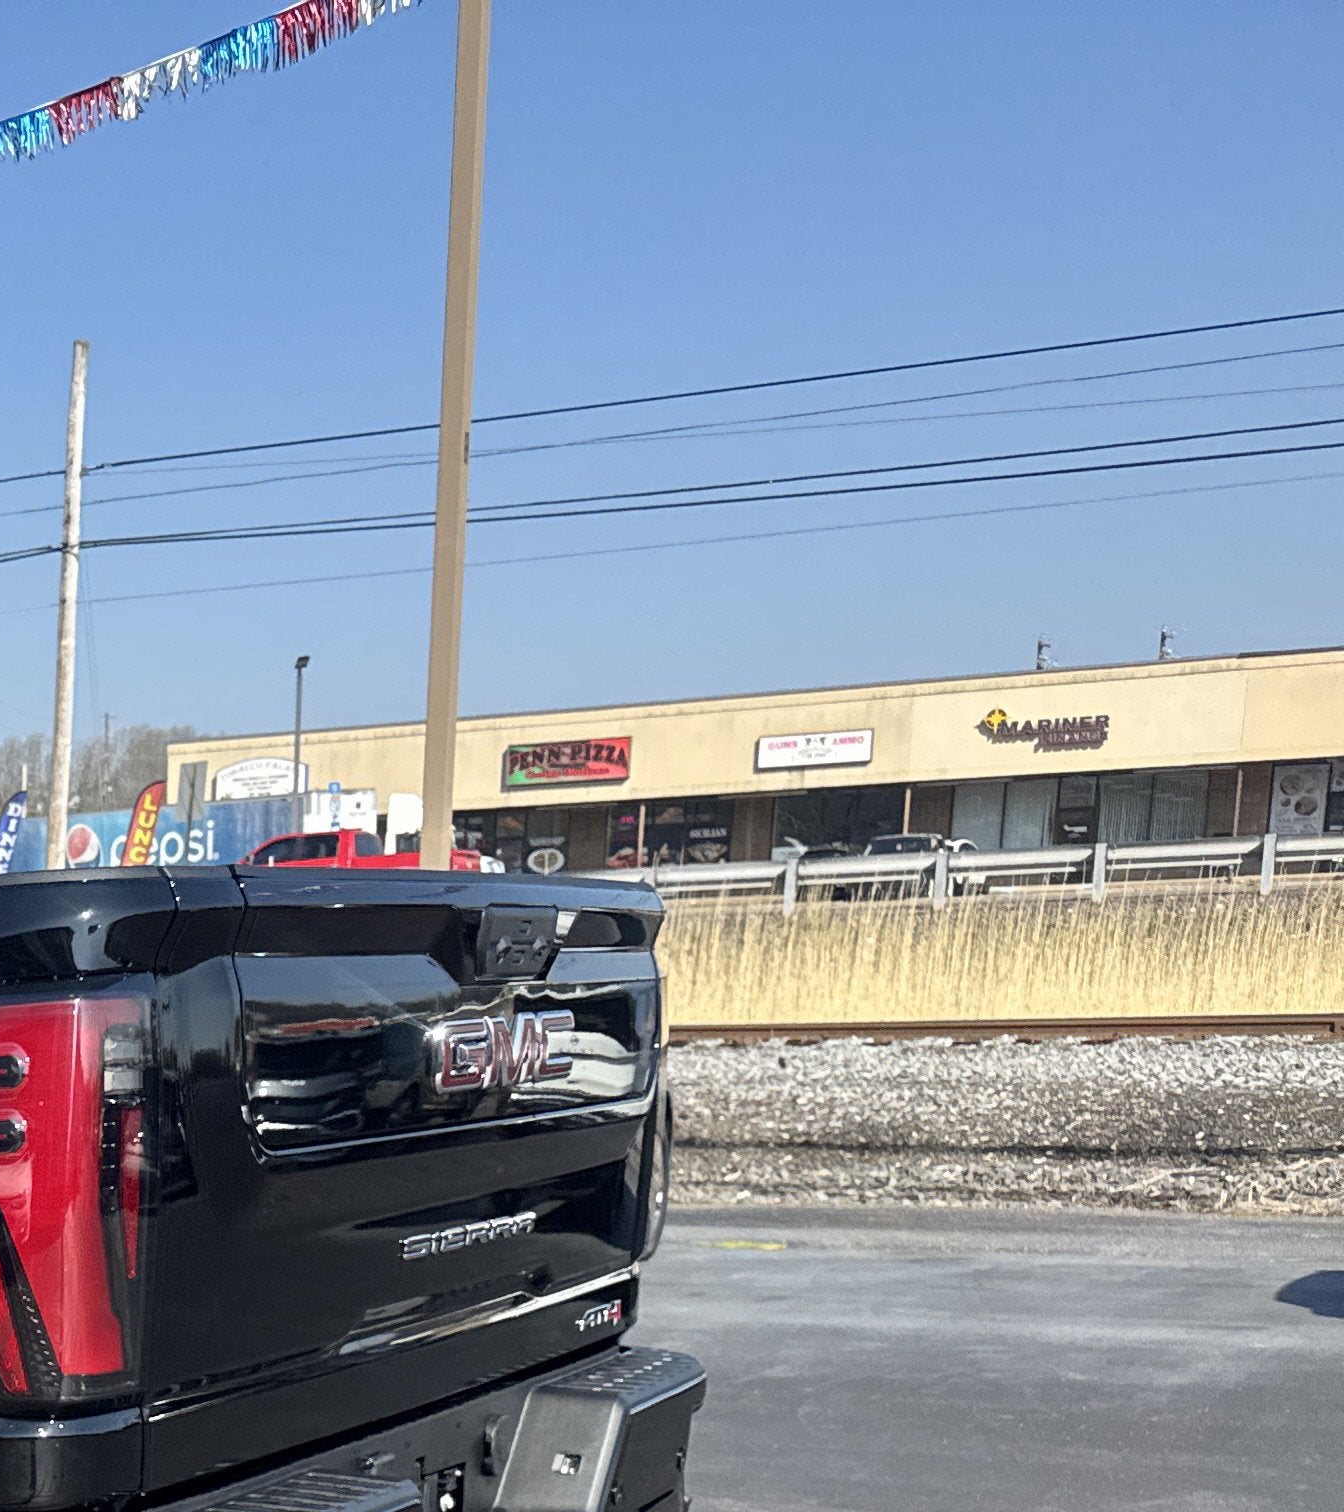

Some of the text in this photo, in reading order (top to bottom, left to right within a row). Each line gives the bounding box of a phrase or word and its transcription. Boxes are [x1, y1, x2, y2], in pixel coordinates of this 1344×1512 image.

[998, 715, 1110, 736] MARINER
[569, 742, 628, 767] PIZZA
[128, 793, 158, 866] LUNC
[435, 1009, 576, 1095] GMC
[402, 1211, 537, 1261] SIERRA
